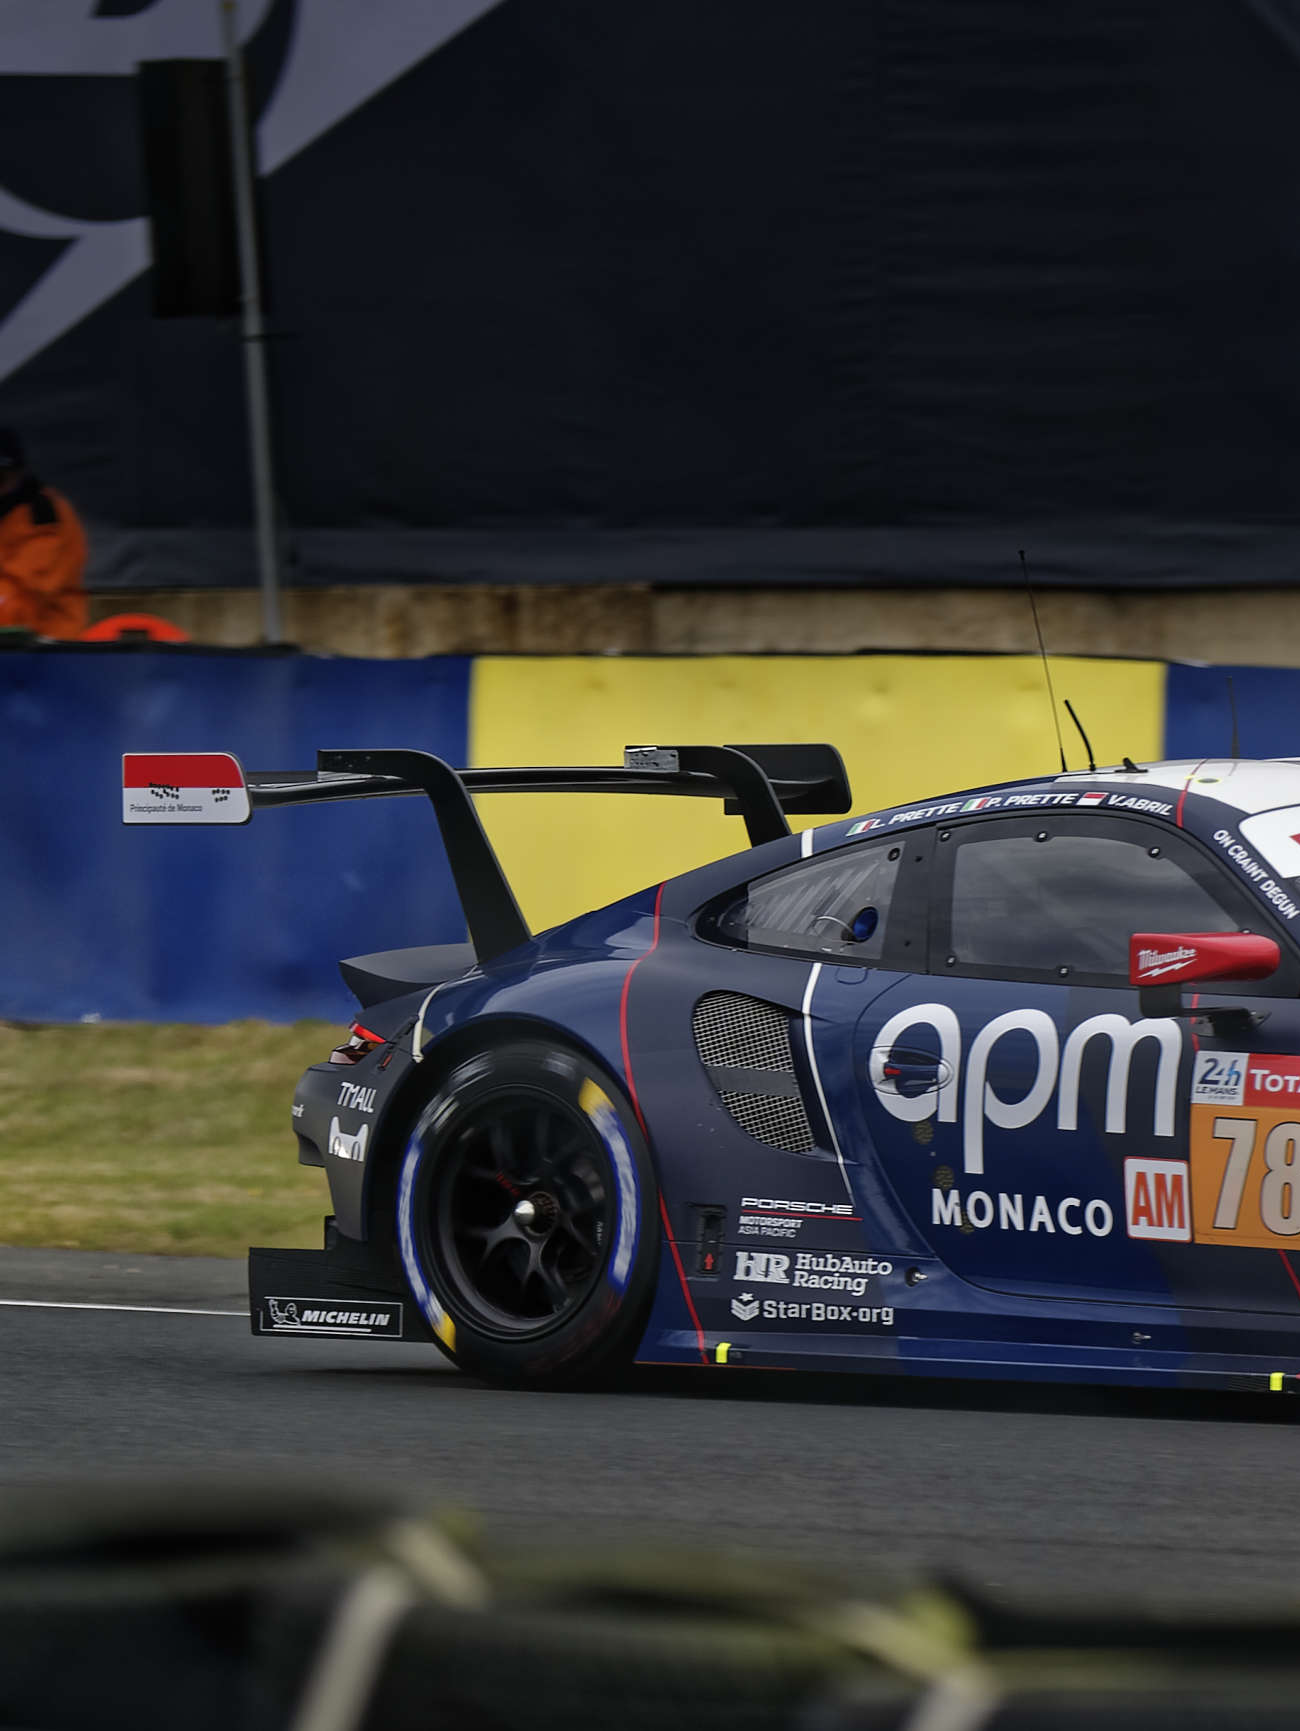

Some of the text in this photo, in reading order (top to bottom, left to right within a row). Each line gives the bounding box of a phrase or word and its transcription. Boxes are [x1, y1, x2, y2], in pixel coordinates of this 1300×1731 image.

[1004, 793, 1079, 806] PRETTE
[888, 802, 963, 825] PRETTE
[1213, 829, 1300, 919] ON CRAINT DEGUN
[337, 1081, 377, 1113] TMALL
[869, 1003, 1182, 1174] apm
[741, 1197, 853, 1215] PORSCHE
[1131, 1170, 1187, 1230] AM
[738, 1215, 803, 1229] MOTORSPORT
[932, 1188, 1114, 1237] MONACO
[737, 1226, 797, 1238] ASIA PACIFIC
[794, 1253, 893, 1276] HubAuto
[792, 1271, 869, 1297] Racing
[301, 1309, 391, 1327] MICHELIN
